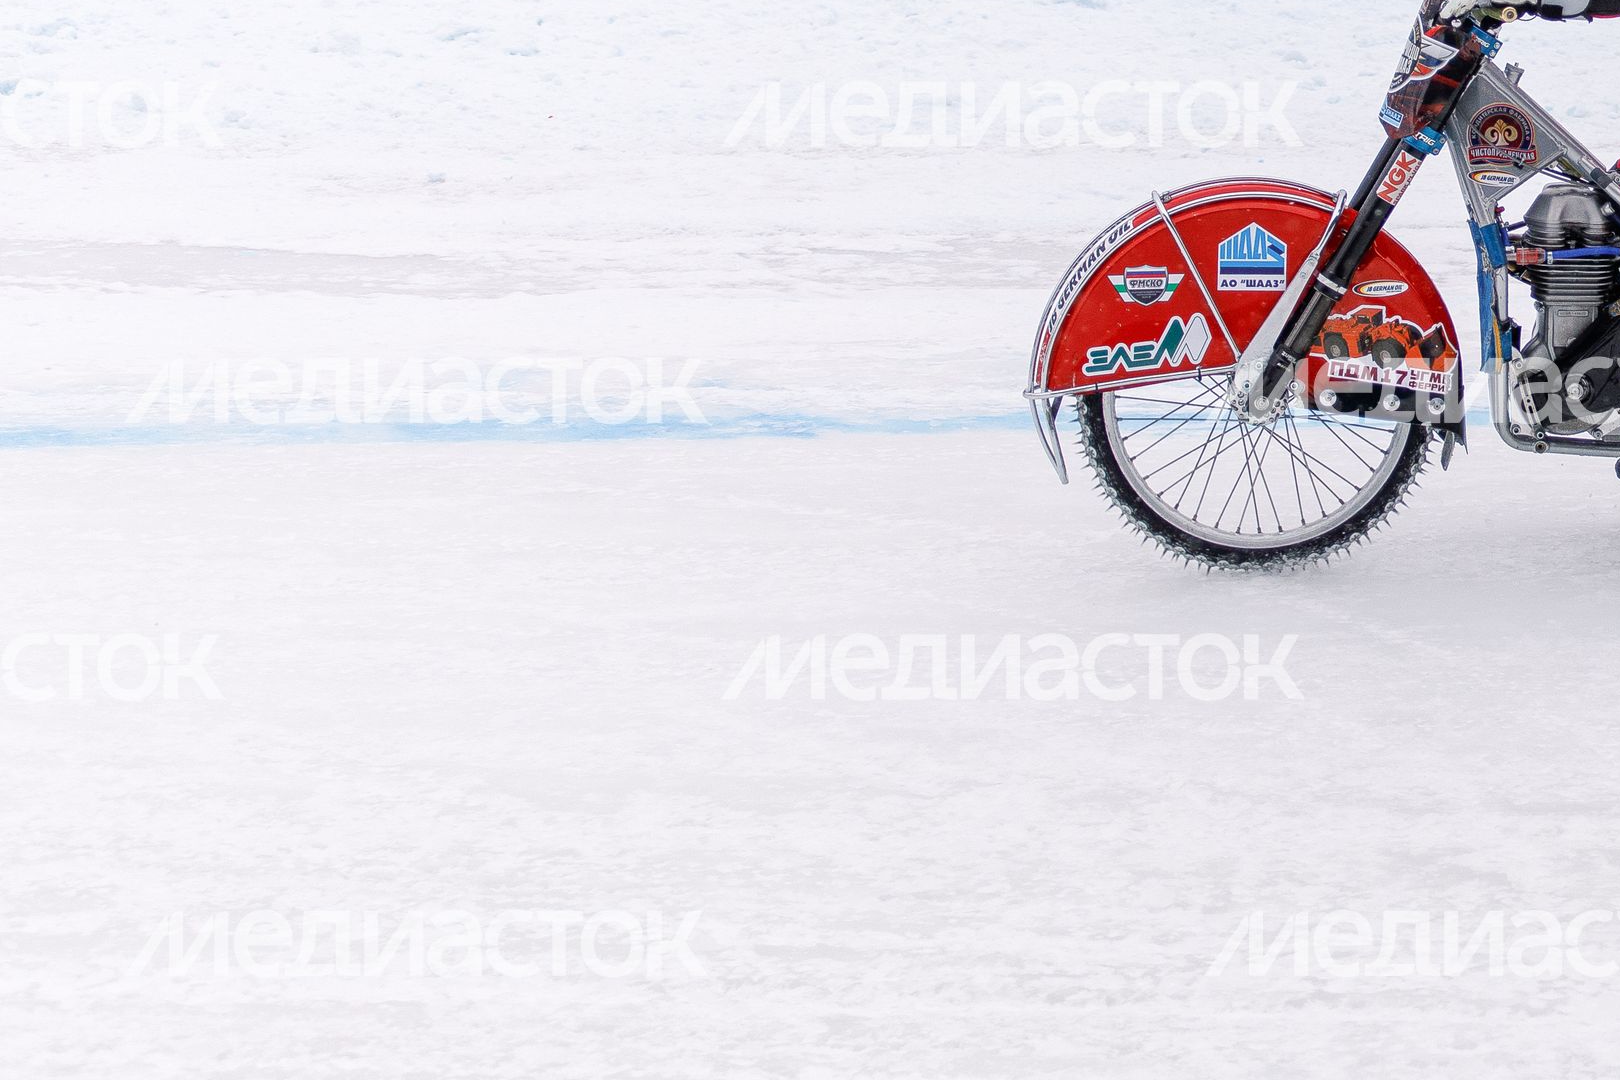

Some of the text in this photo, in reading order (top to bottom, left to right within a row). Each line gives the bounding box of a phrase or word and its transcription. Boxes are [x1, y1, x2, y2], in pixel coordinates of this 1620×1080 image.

[1378, 152, 1417, 203] NGK
[1057, 240, 1106, 309] GERMAN
[1130, 279, 1164, 289] ФМСКО
[1221, 279, 1238, 288] АО
[1373, 284, 1394, 292] GERMAN
[1331, 360, 1378, 382] ПДМ
